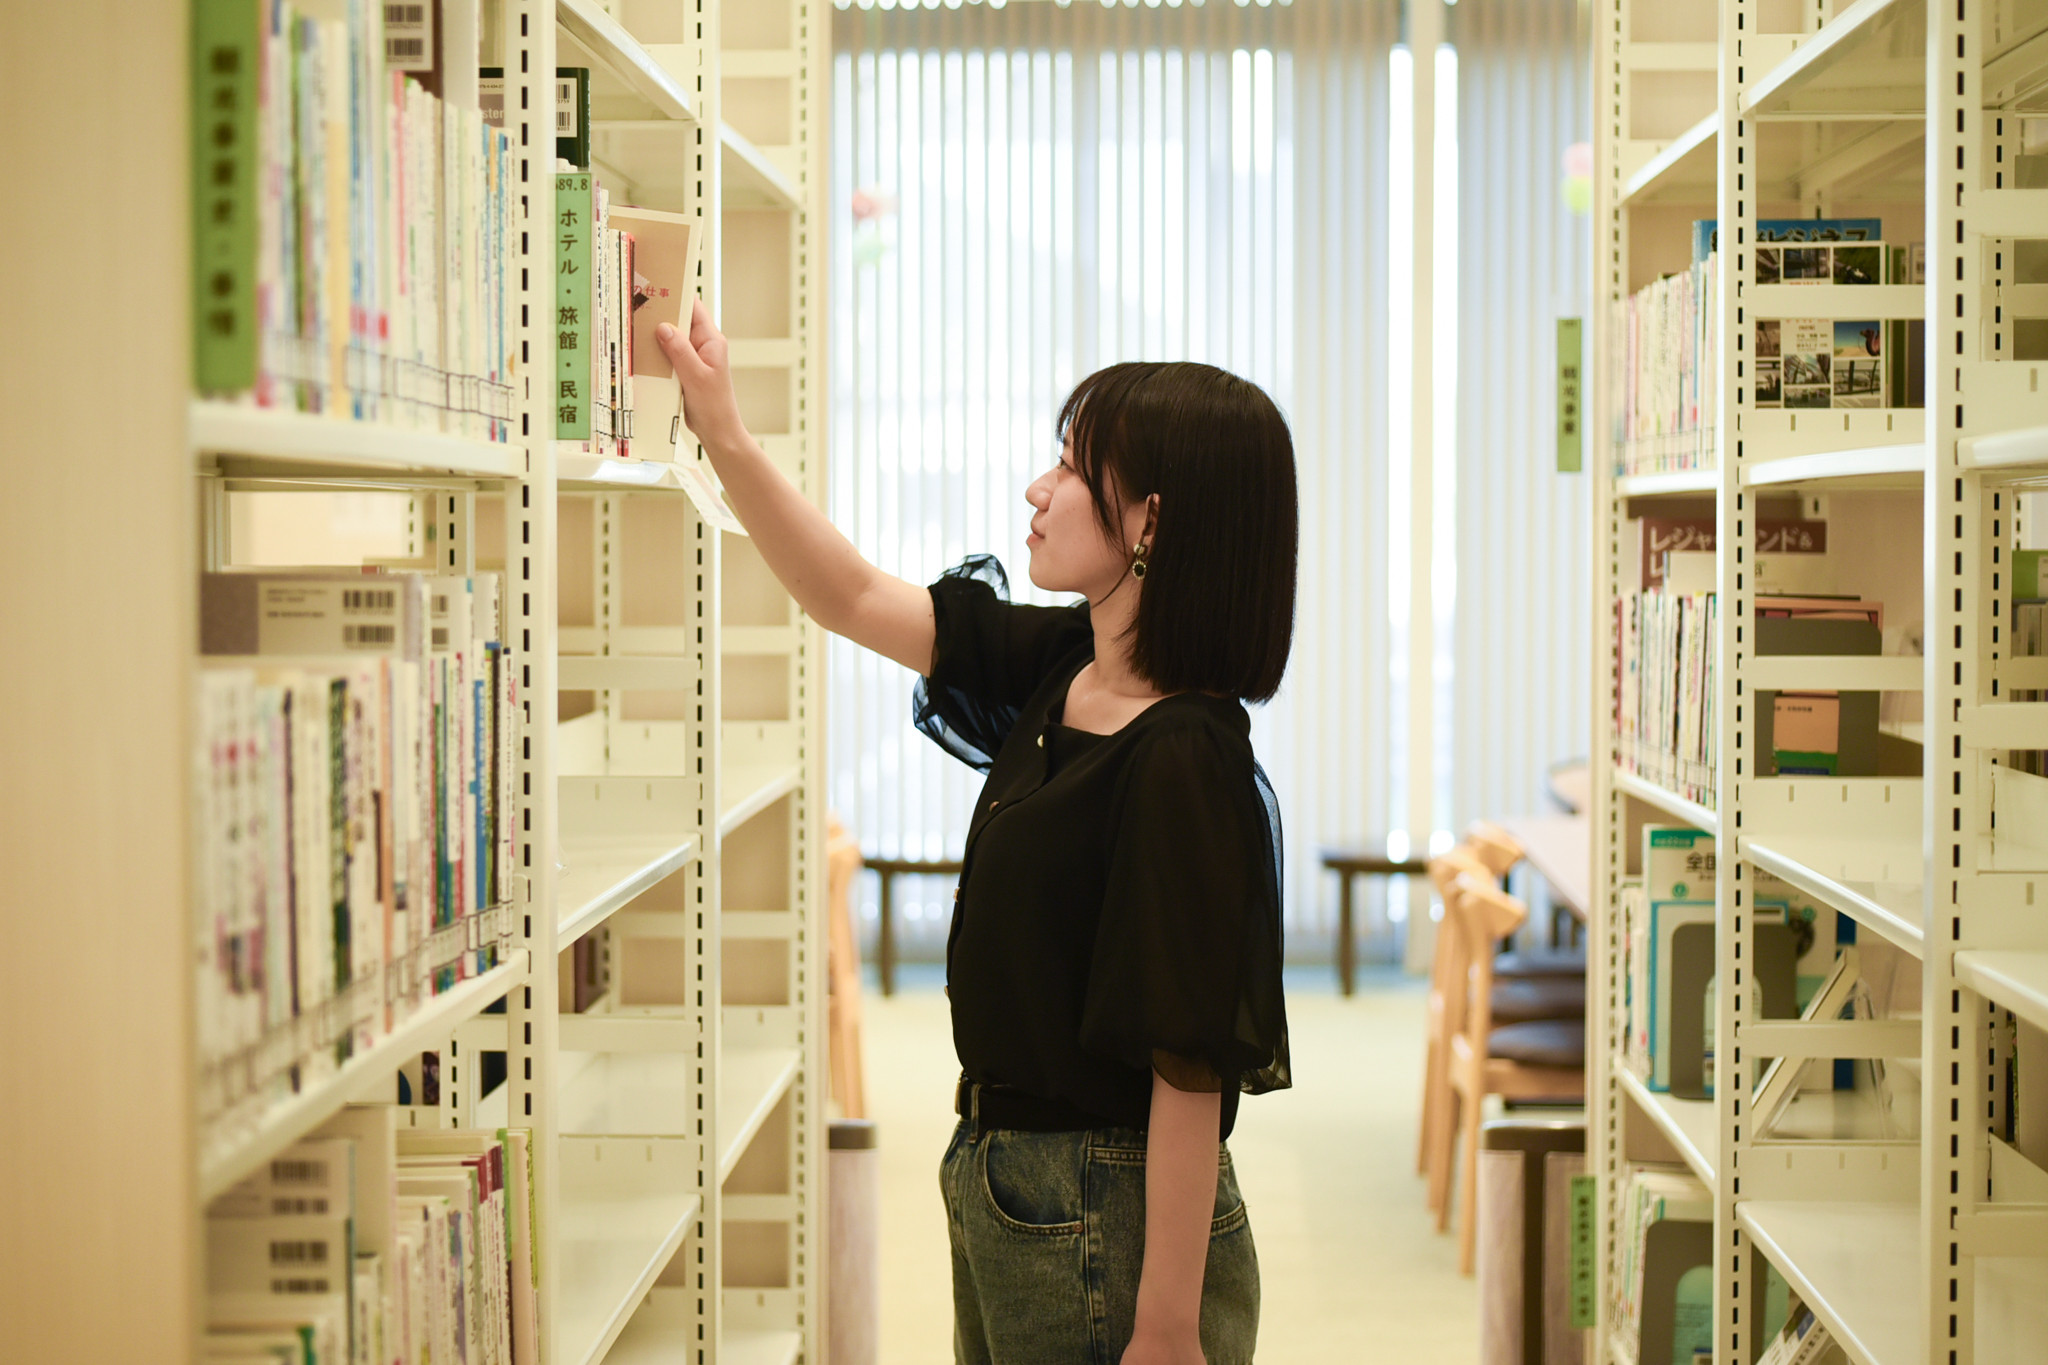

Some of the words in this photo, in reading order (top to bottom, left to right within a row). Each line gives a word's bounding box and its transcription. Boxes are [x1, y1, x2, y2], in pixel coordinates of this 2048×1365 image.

[559, 209, 579, 424] ホテル・旅館・民宿
